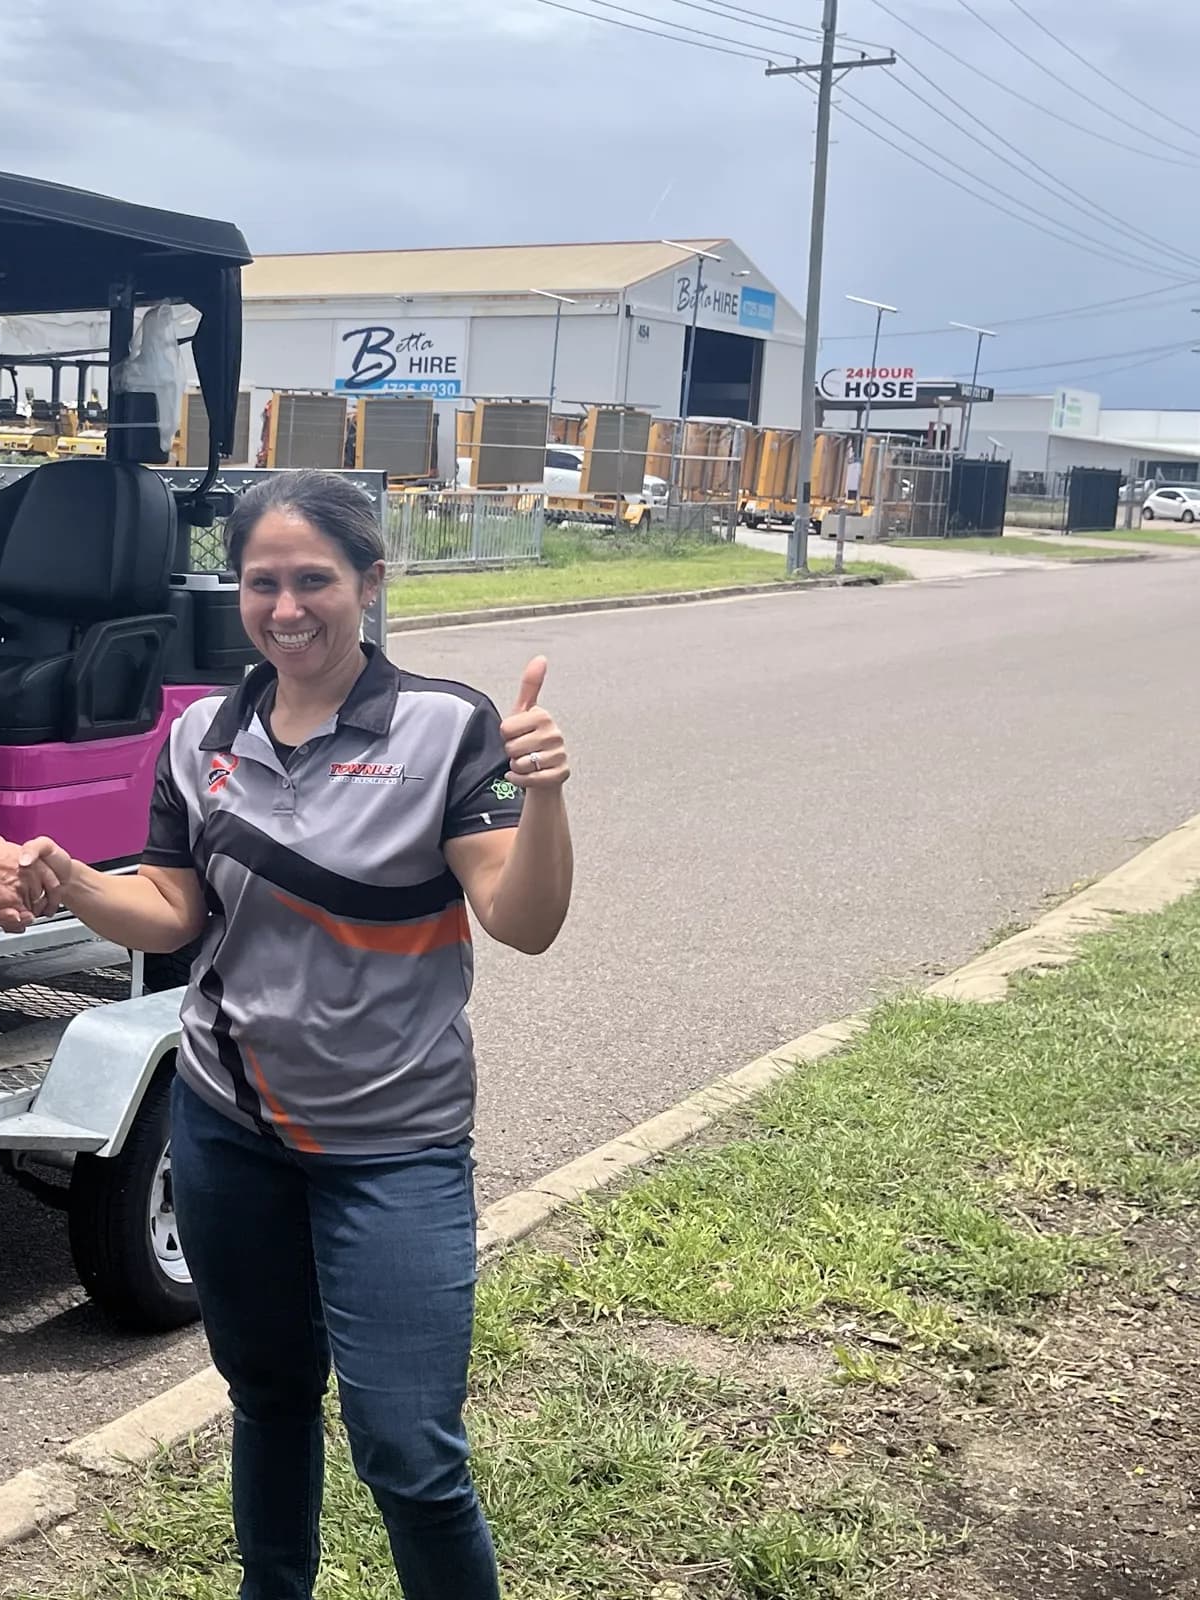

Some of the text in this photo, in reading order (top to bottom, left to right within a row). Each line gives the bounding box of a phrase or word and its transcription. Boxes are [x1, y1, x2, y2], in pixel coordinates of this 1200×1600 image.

[713, 290, 738, 315] HIRE
[342, 326, 434, 389] Betta
[409, 356, 457, 374] HIRE
[845, 382, 915, 398] HOSE
[330, 763, 403, 776] TOWNLEC
